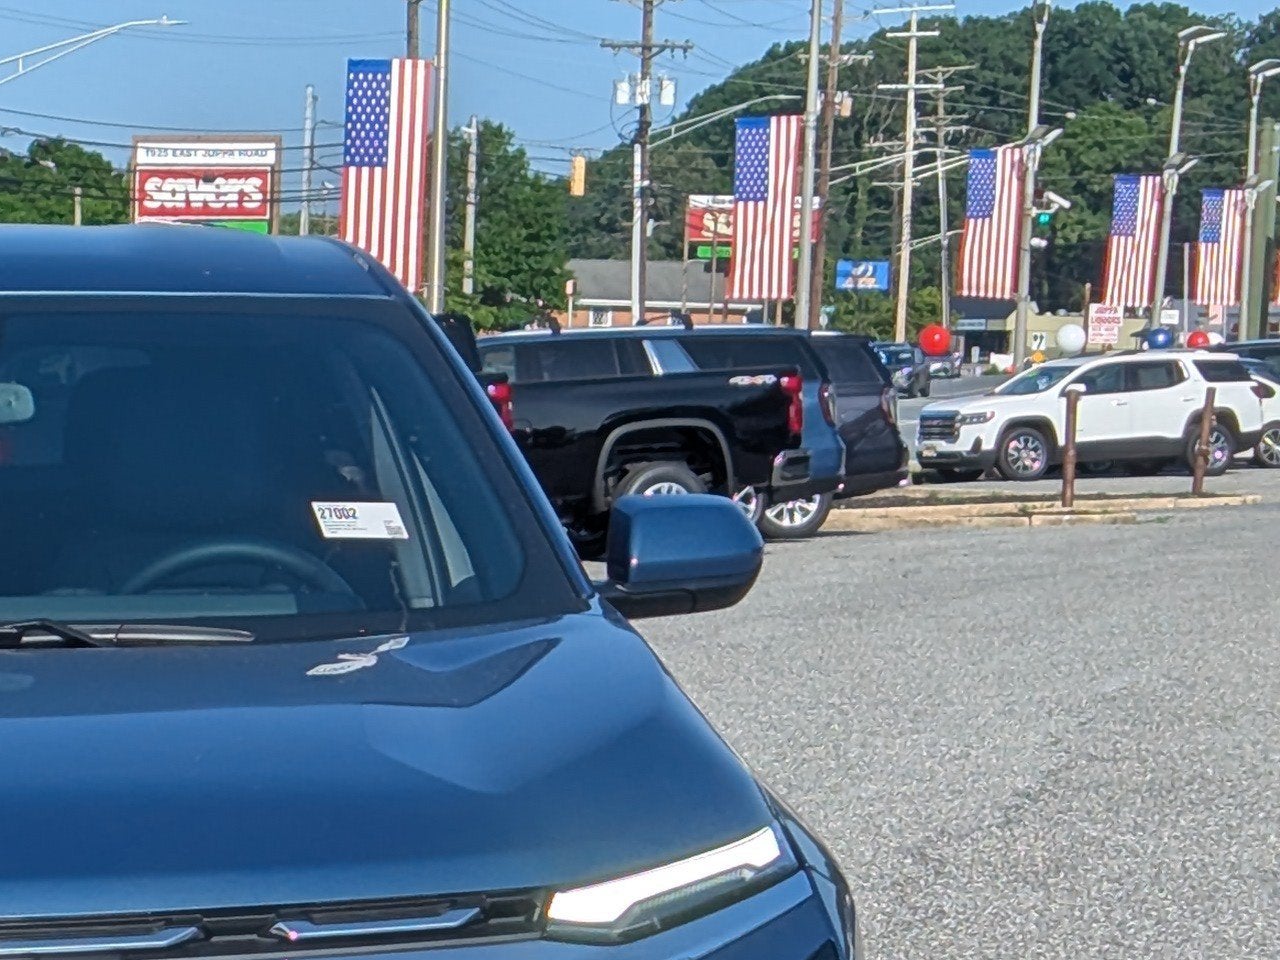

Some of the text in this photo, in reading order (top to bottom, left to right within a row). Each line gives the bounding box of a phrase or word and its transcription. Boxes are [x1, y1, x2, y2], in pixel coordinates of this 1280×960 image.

[172, 149, 198, 158] EAST
[239, 149, 268, 158] ROAD
[317, 506, 358, 520] 27002
